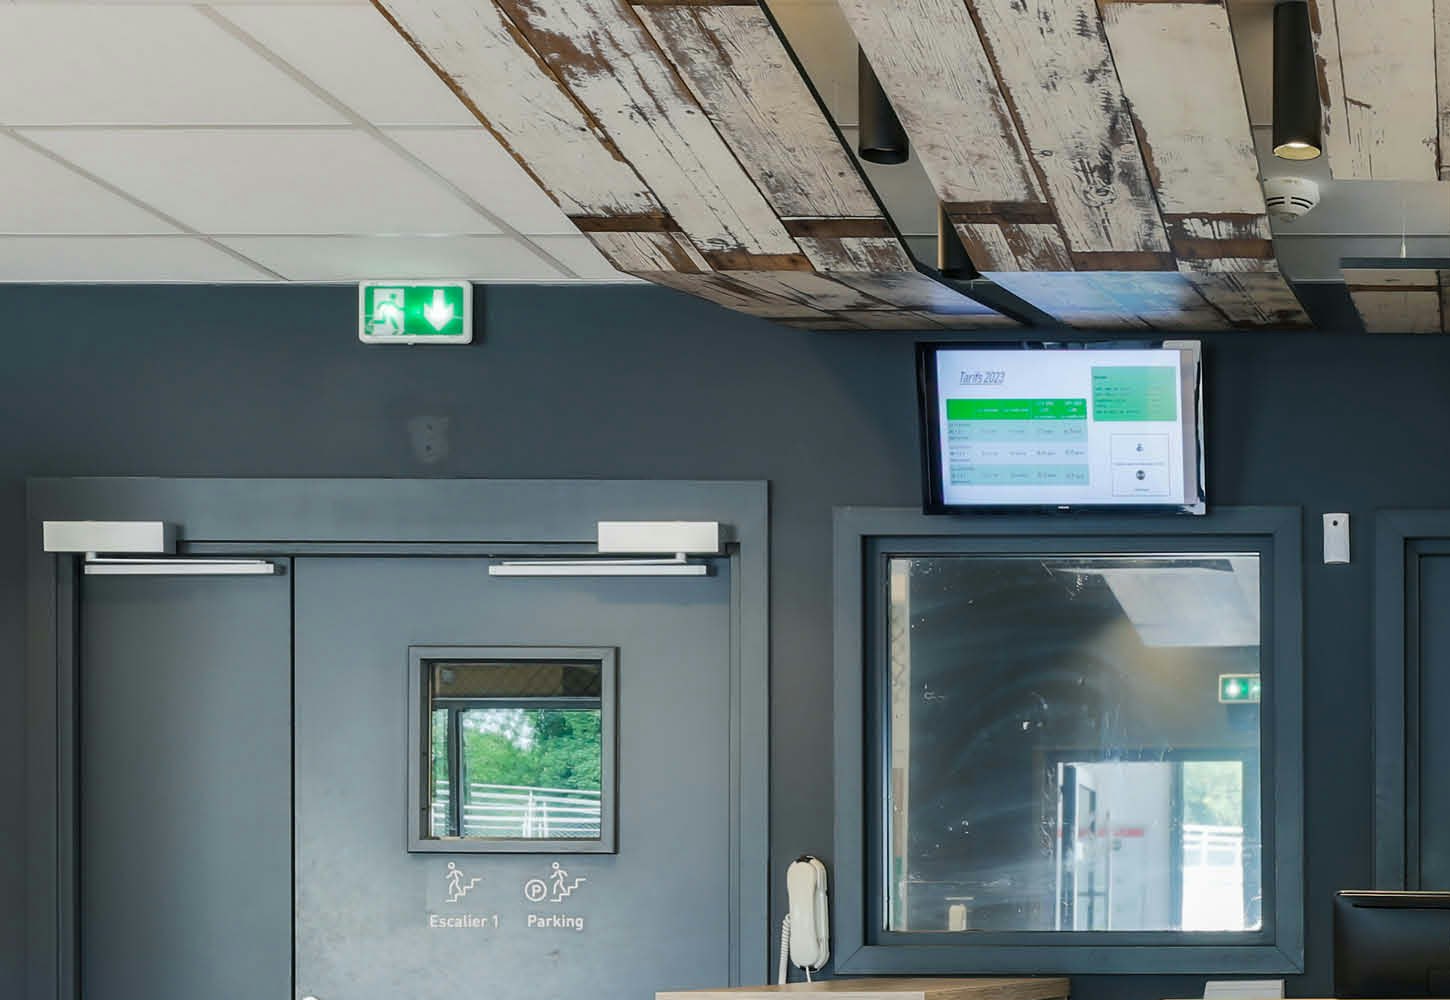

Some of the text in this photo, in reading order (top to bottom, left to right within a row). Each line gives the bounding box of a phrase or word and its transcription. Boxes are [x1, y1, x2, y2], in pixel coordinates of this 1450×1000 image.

[960, 371, 1006, 385] Tarifs 2023
[429, 914, 499, 928] Escalier 1
[527, 914, 584, 931] Parking
